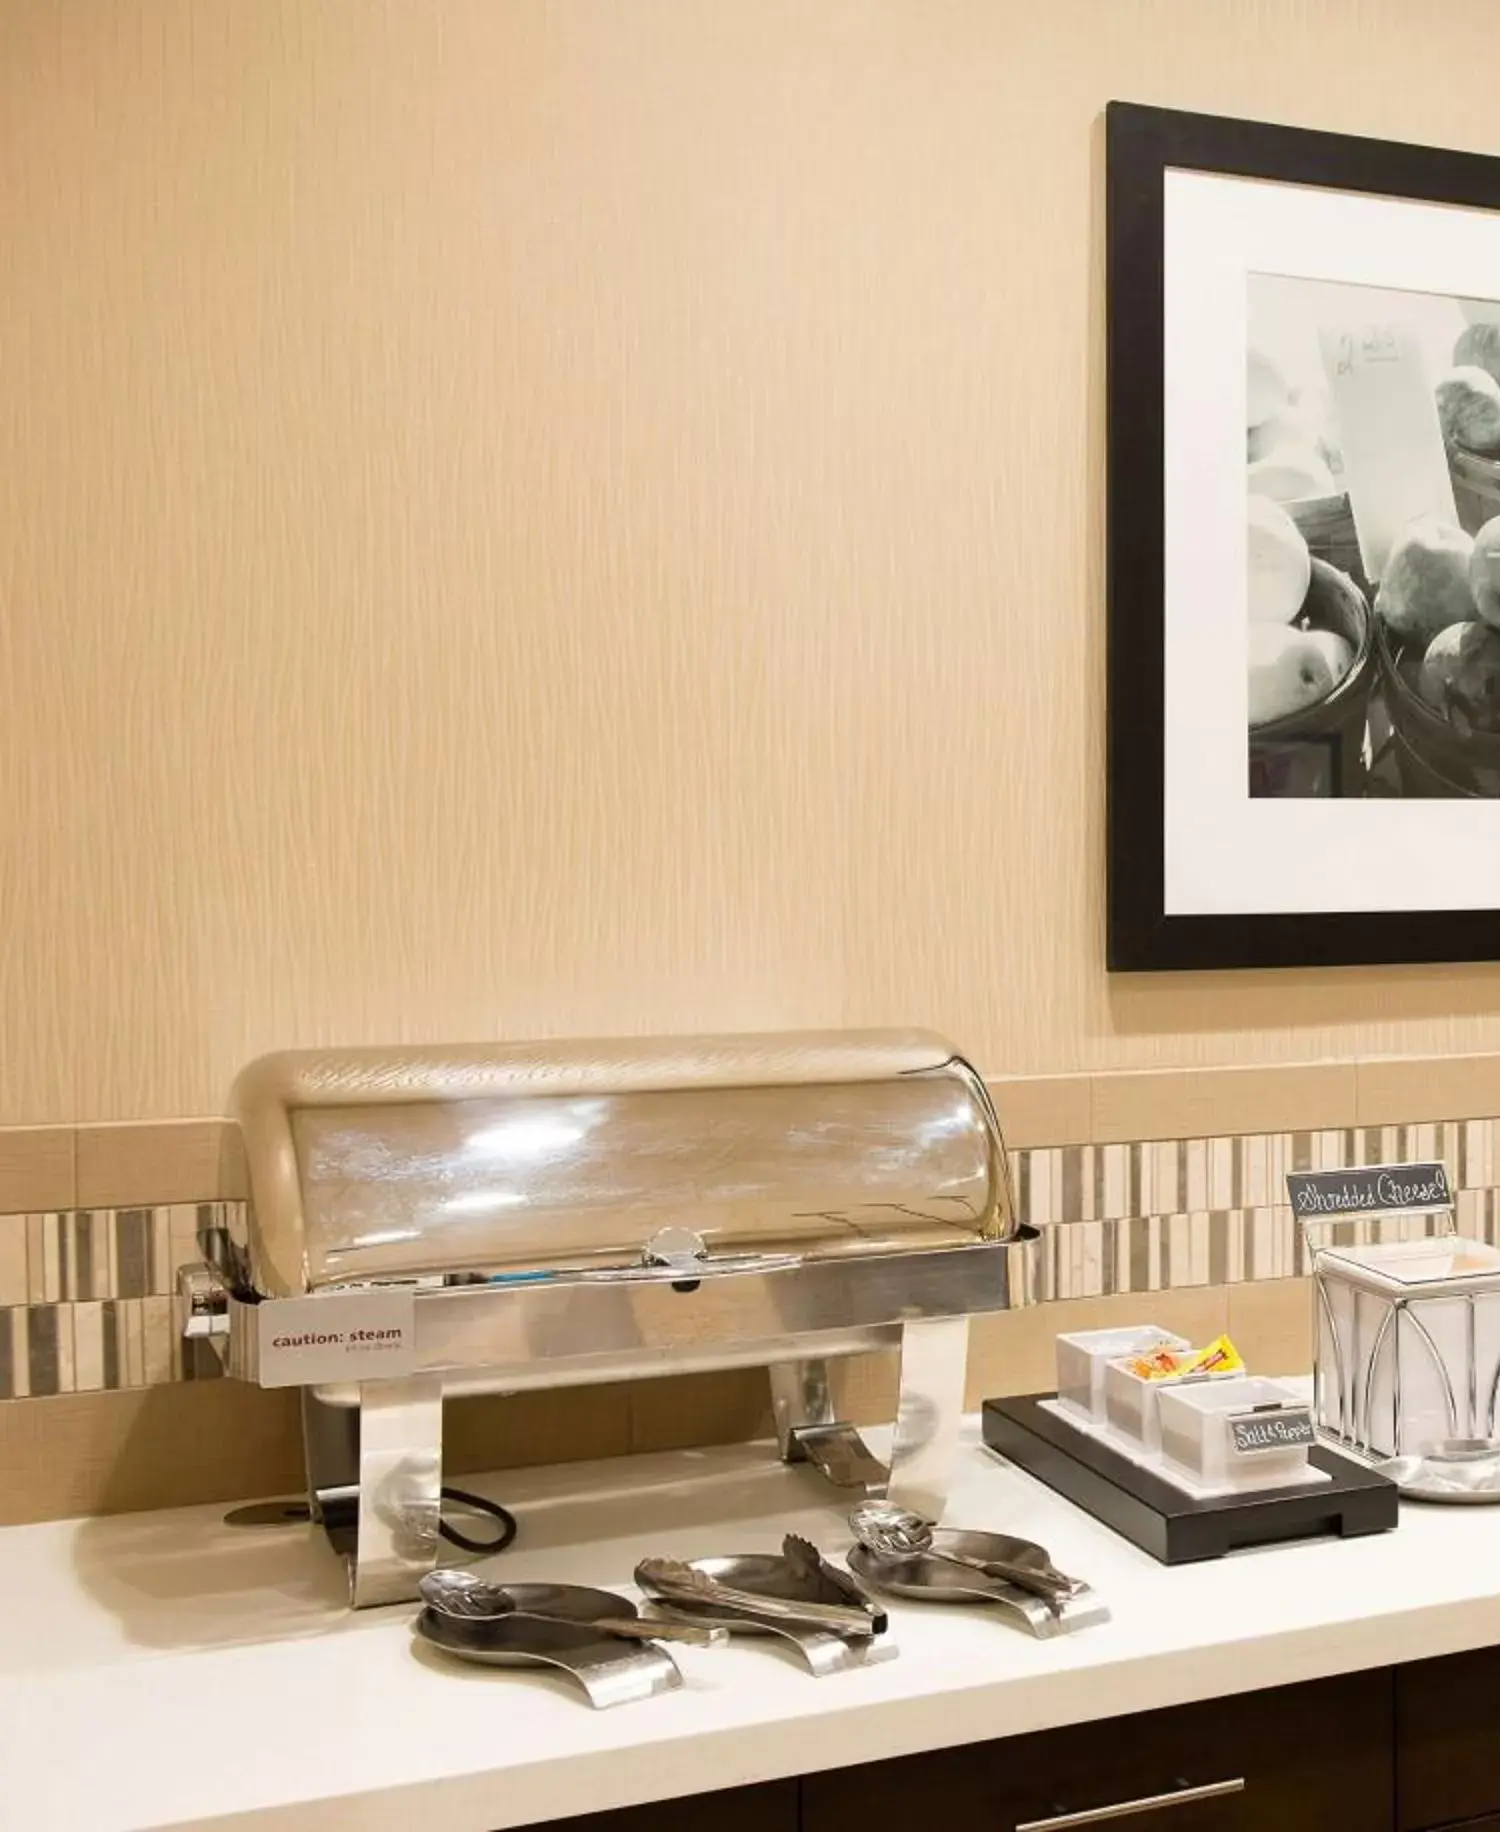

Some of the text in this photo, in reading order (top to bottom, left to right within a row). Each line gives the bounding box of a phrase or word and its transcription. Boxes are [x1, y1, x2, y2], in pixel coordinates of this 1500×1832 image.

[1298, 1183, 1376, 1211] Shredded
[272, 1332, 344, 1348] caution:
[350, 1328, 402, 1342] steam
